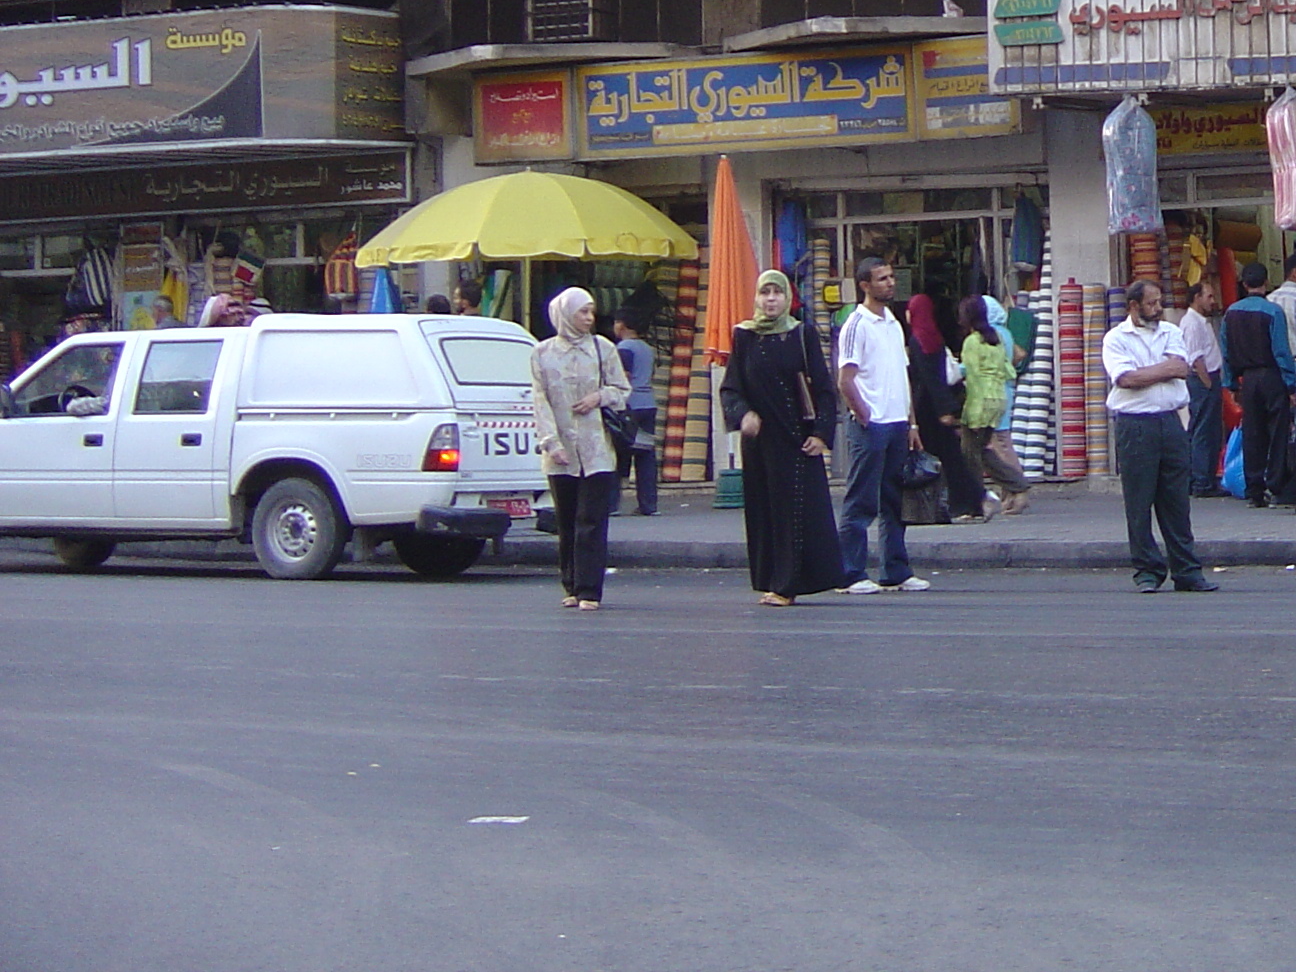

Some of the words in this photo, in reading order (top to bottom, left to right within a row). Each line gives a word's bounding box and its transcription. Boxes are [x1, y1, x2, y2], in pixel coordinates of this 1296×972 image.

[165, 26, 247, 53] مؤسسة
[588, 68, 689, 127] التجارية
[688, 60, 800, 124] السيوري
[802, 55, 905, 109] شركة
[484, 432, 542, 457] ISU
